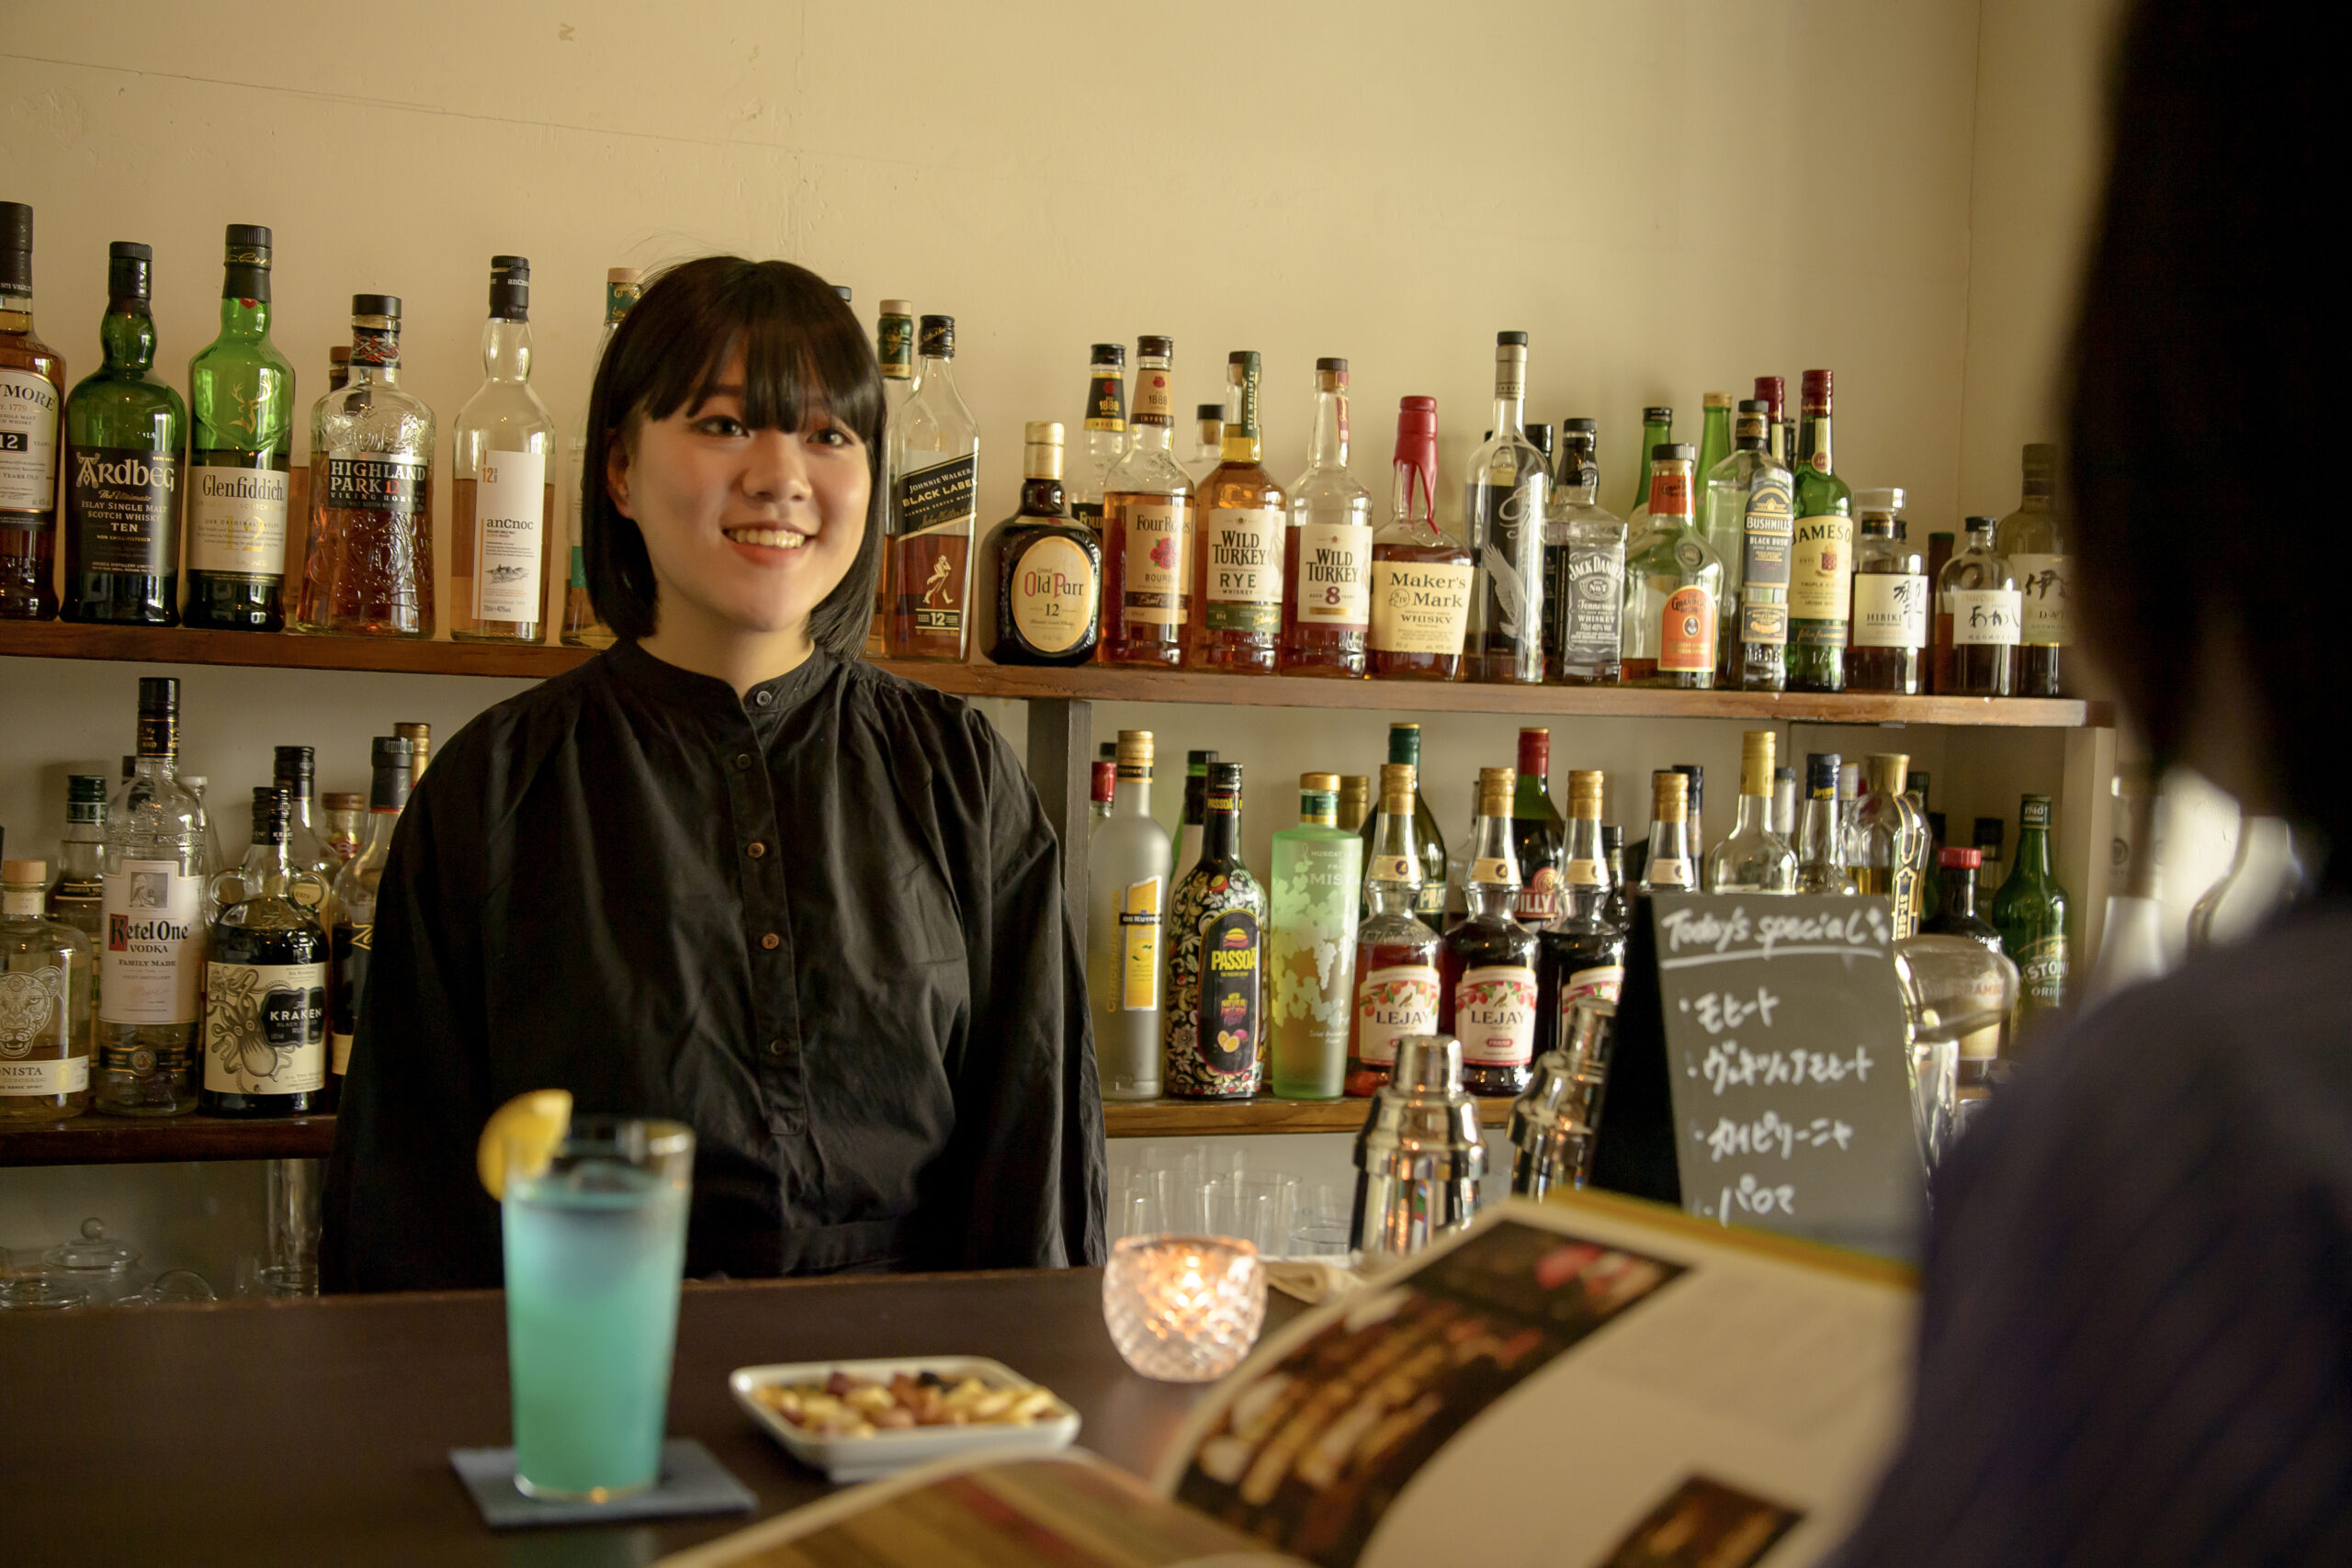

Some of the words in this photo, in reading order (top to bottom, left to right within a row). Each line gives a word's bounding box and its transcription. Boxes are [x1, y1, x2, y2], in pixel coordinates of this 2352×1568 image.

[0, 383, 56, 412] MORE
[1148, 394, 1168, 405] 1888
[1099, 400, 1120, 412] 1888
[331, 461, 425, 481] HIGHLAND
[481, 467, 493, 483] 12
[203, 474, 284, 502] Glenfiddich
[331, 477, 382, 494] PARK
[385, 479, 400, 494] 12
[909, 477, 941, 494] JOHNNIE
[941, 468, 972, 482] WALKER
[331, 491, 377, 501] VIKING
[902, 489, 941, 507] BLACK
[943, 477, 978, 495] LABEL
[82, 501, 105, 509] ISLAY
[107, 502, 143, 512] SINGLE
[145, 505, 168, 514] MALT
[87, 511, 122, 520] SCOTCH
[125, 513, 162, 523] WHISKY
[486, 518, 534, 530] anCnoc
[1136, 514, 1164, 532] Four
[1747, 516, 1792, 531] BUSHMILLS
[110, 522, 139, 534] TEN
[1792, 524, 1851, 545] JAMESO
[1221, 530, 1260, 548] WILD
[1749, 536, 1770, 545] BLACK
[1771, 536, 1789, 547] BUSH
[1212, 544, 1267, 567] TURKEY
[1316, 547, 1353, 566] WILD
[1306, 561, 1359, 583] TURKEY
[1568, 558, 1593, 581] JACK
[1023, 570, 1050, 597] Old
[1052, 572, 1084, 599] Parr
[1219, 572, 1257, 588] RYE
[1389, 571, 1466, 589] Maker's
[1325, 586, 1340, 604] 8
[1412, 592, 1463, 607] Mark
[1046, 603, 1059, 616] 12
[931, 612, 945, 626] 12
[1401, 614, 1452, 624] WHISKY
[1577, 615, 1616, 623] WHISKEY
[1866, 613, 1902, 623] HIBIKI
[1897, 893, 1909, 941] ST-GER
[110, 917, 154, 950] Ketel
[156, 919, 189, 941] One
[1661, 906, 1751, 953] Today's
[1754, 907, 1868, 962] special
[130, 944, 169, 953] VODKA
[119, 959, 149, 967] FAMILY
[269, 1009, 322, 1021] KRAKEN
[1376, 1011, 1430, 1024] LEJAY
[1471, 1010, 1526, 1024] LEJAY
[0, 1066, 43, 1076] NISTA
